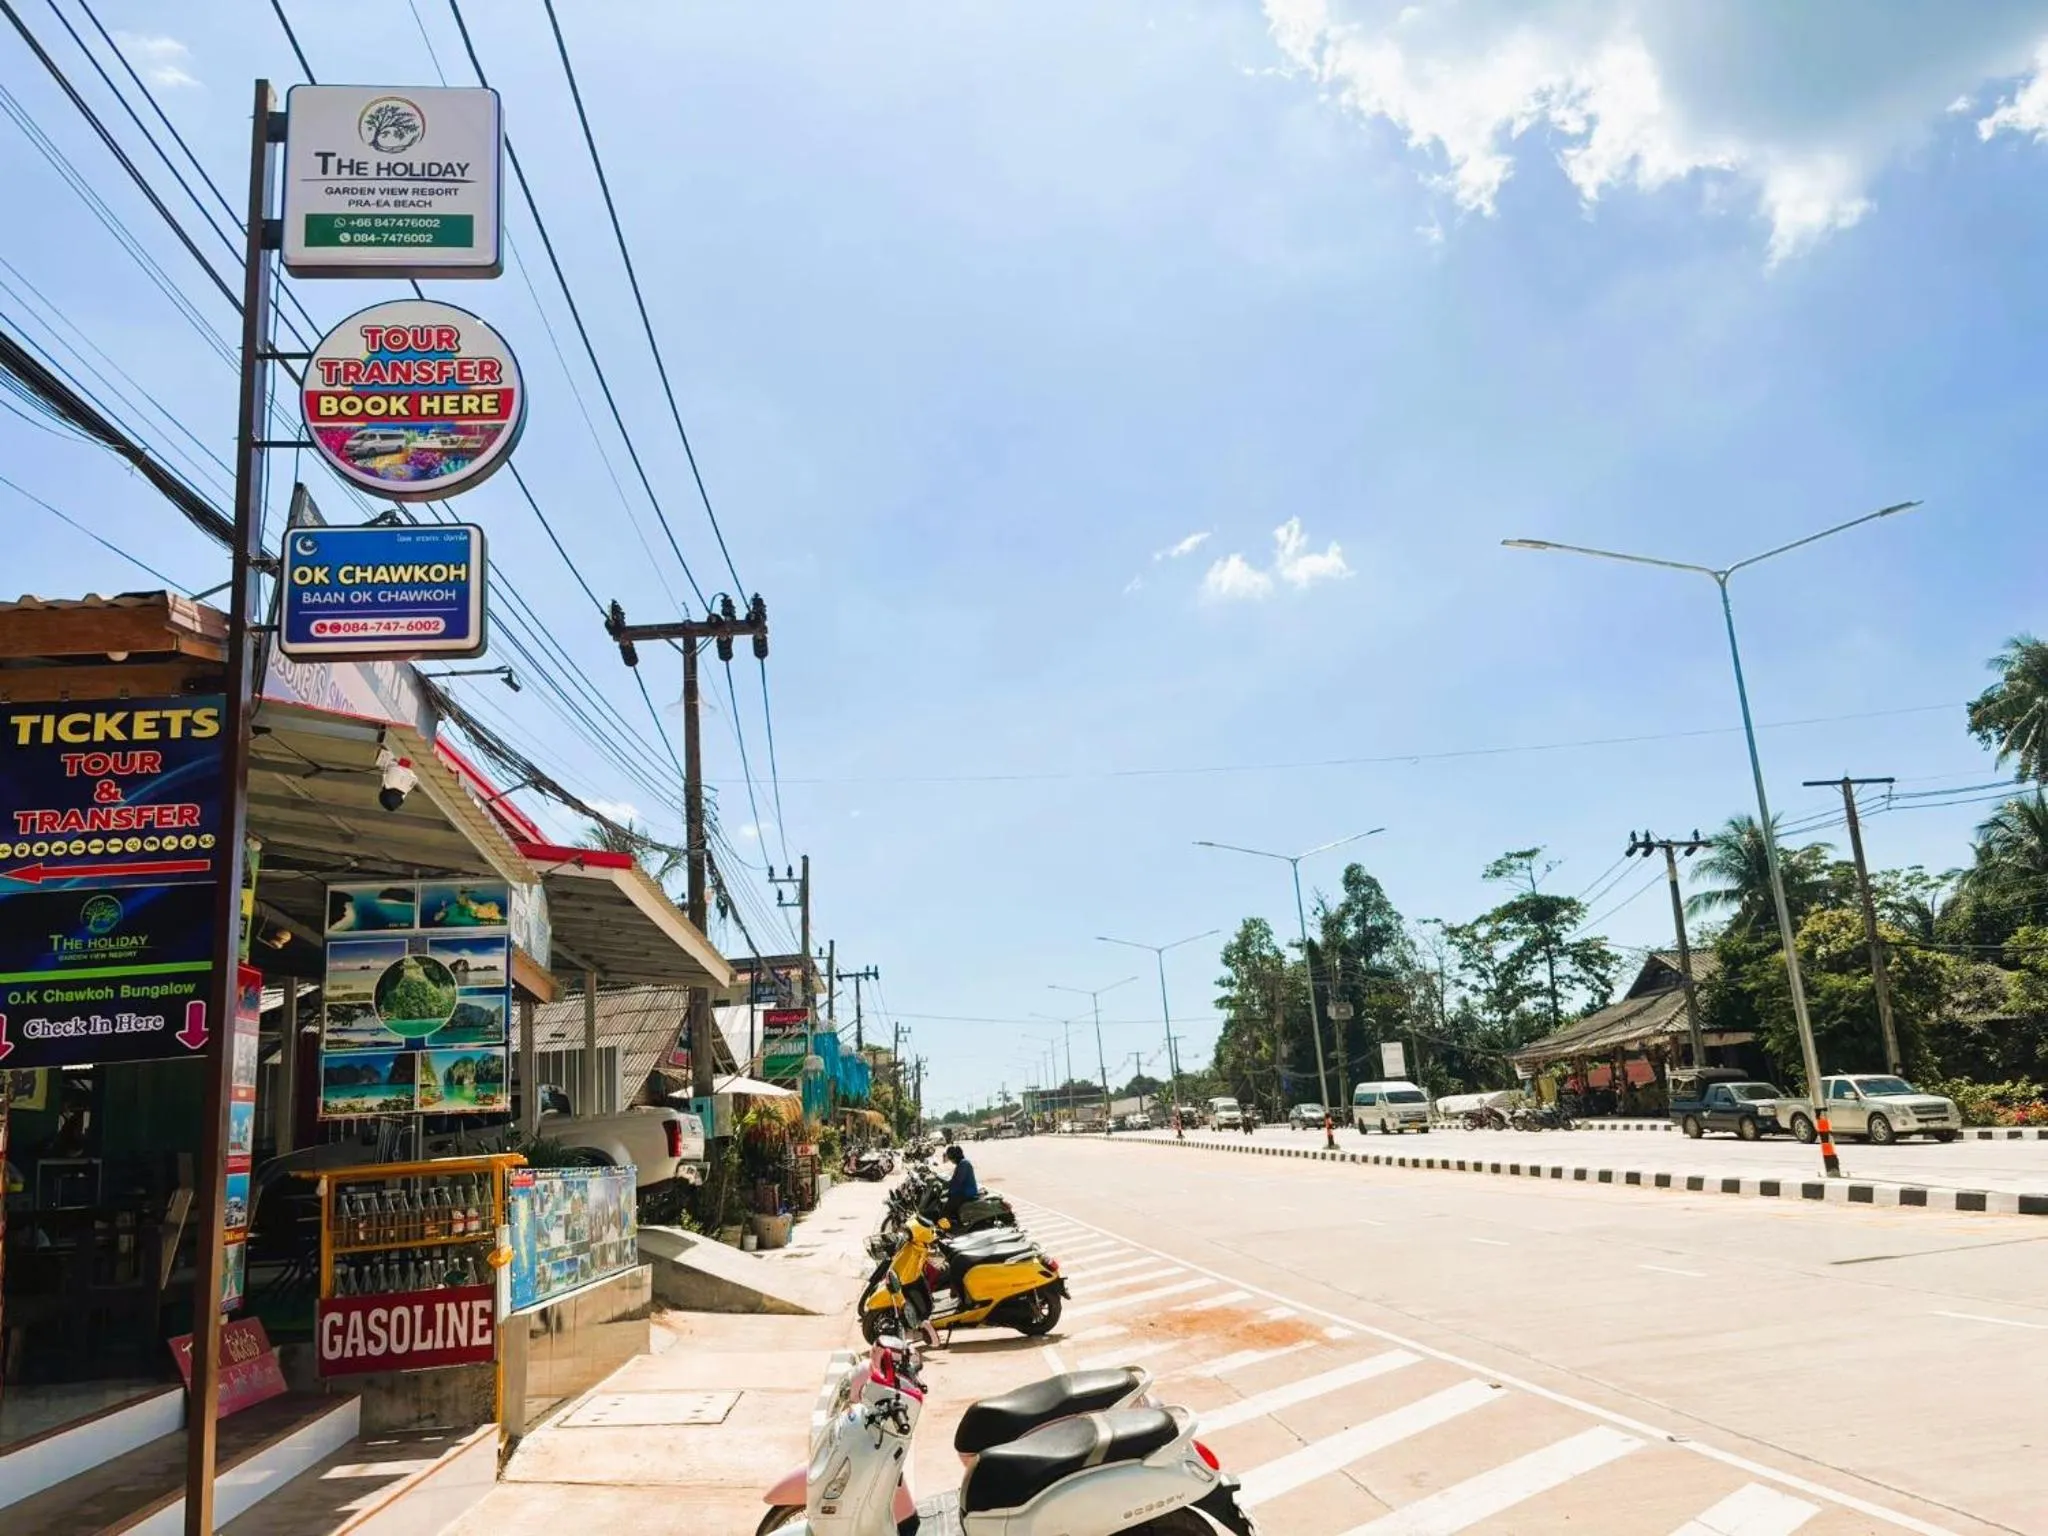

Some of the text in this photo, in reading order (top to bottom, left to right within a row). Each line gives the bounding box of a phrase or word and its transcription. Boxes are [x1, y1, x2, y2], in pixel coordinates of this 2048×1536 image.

[314, 152, 470, 177] THE HOLIDAY
[325, 187, 459, 197] GARDEN VIEW RESORT
[348, 199, 433, 209] PRA-EA BEACH
[349, 218, 441, 228] +66 847476002
[353, 233, 433, 243] 084-7476002
[361, 325, 460, 353] TOUR
[317, 358, 502, 385] TRANSFER
[318, 393, 499, 417] BOOK HERE
[293, 563, 467, 585] OK CHAWKOH
[302, 589, 456, 604] BAAN OK CHAWKOH
[342, 619, 441, 634] 084-747-6002
[10, 707, 221, 745] TICKETS
[61, 751, 162, 777] TOUR
[94, 779, 124, 804] &
[14, 803, 201, 835] TRANSFER
[88, 934, 149, 949] HOLIDAY
[8, 982, 196, 1005] O.K Chawkoh Bungalow
[24, 1013, 164, 1039] Check In Here
[321, 1299, 494, 1361] GASOLINE
